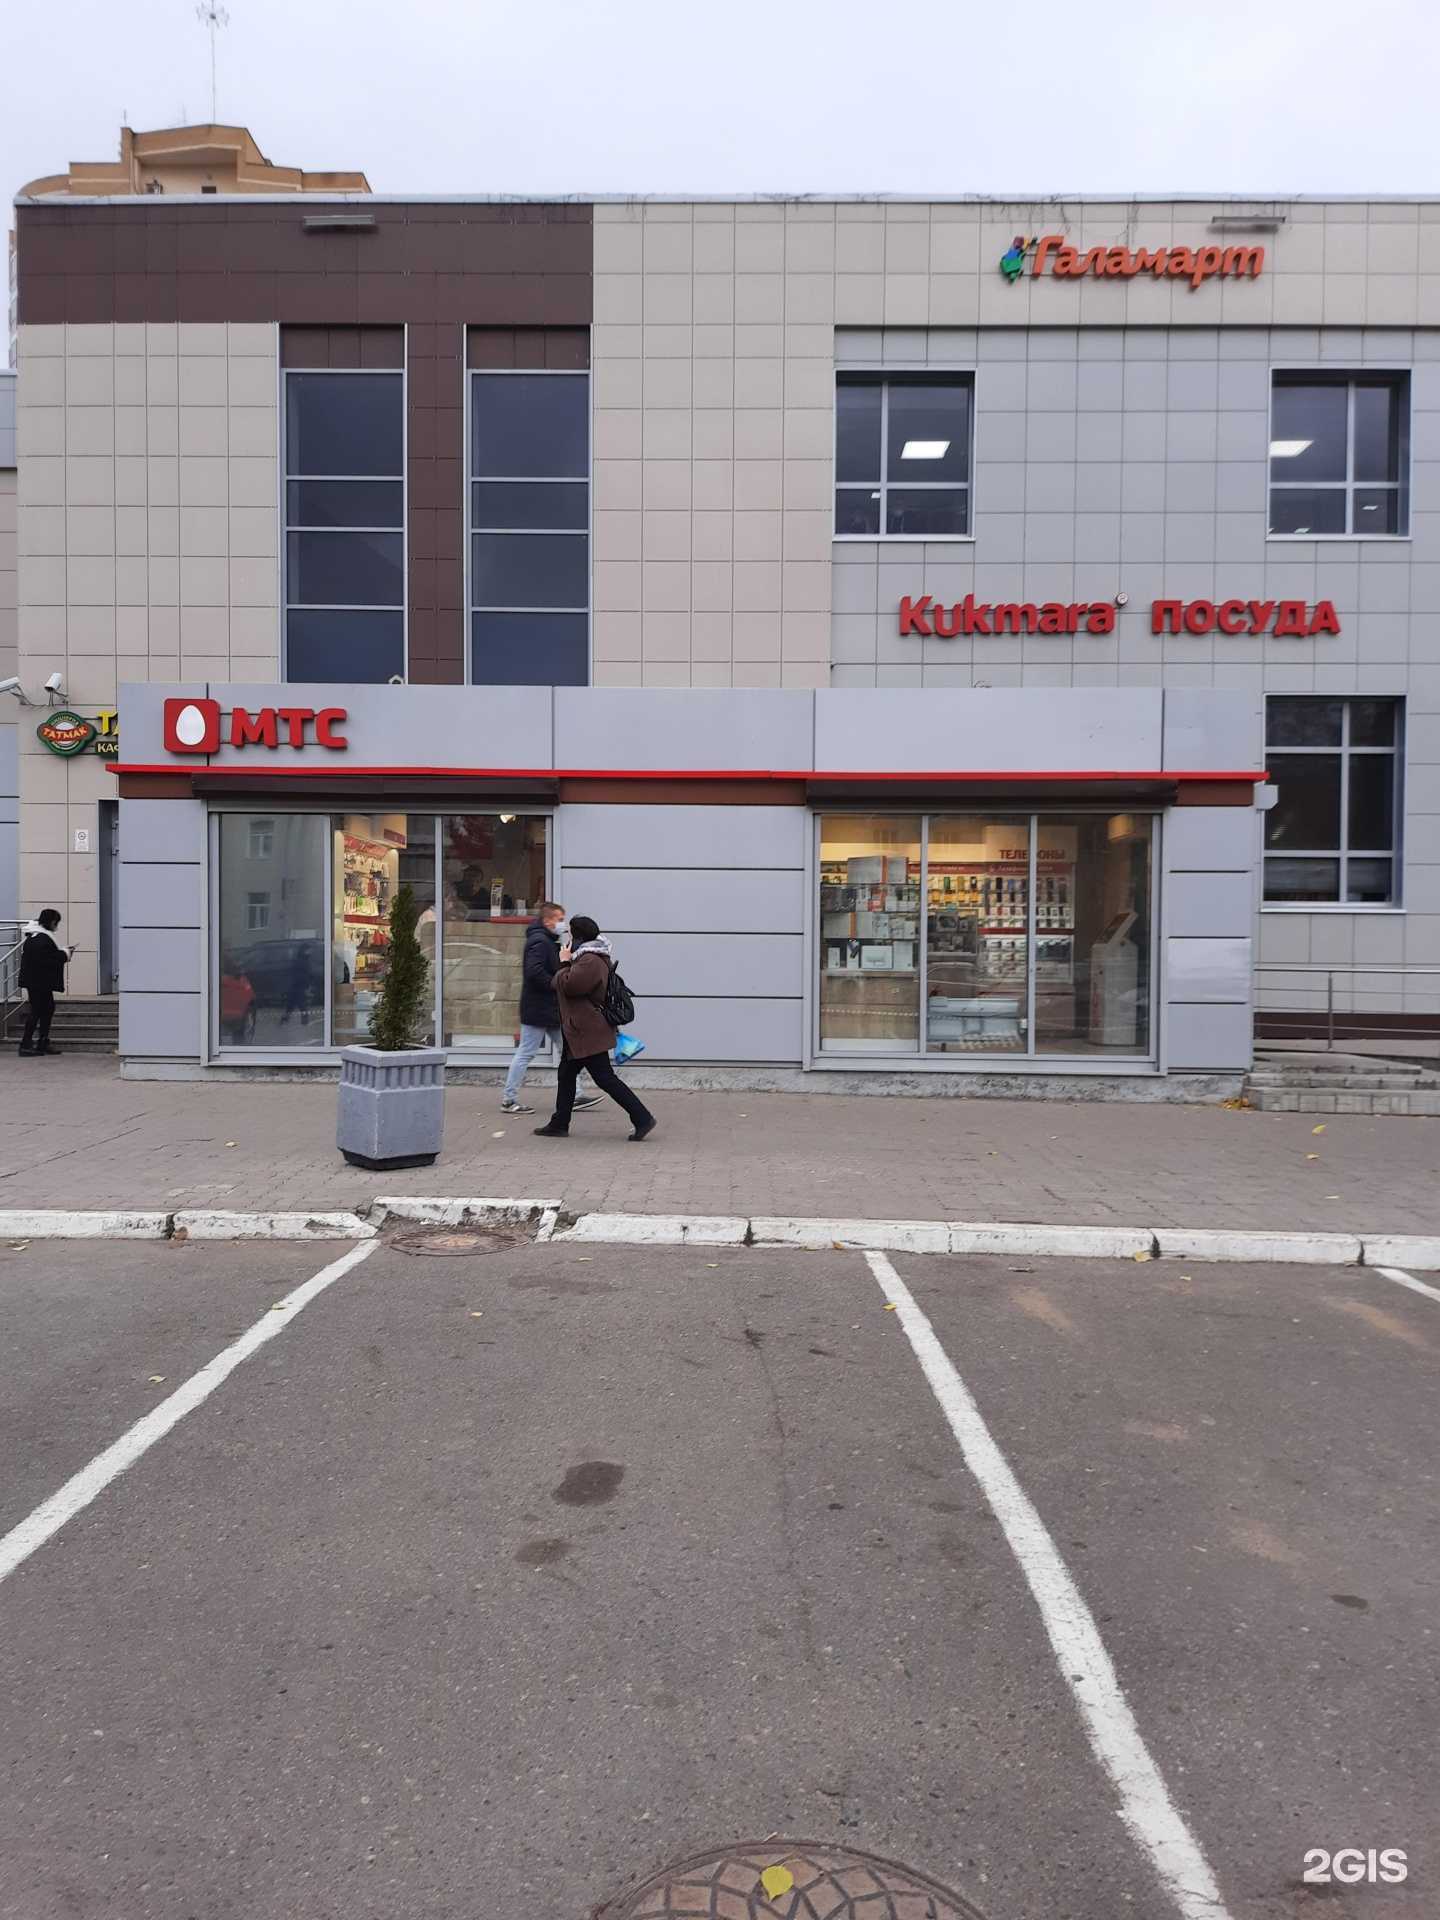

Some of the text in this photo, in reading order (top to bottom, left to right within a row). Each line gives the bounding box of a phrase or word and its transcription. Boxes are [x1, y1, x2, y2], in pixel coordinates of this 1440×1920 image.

[1031, 235, 1265, 289] Галамарт
[899, 594, 1115, 638] Kukmara
[1151, 600, 1341, 637] ПОСУДА
[231, 708, 348, 750] МТС
[1000, 849, 1065, 860] ТЕЛЕОНЫ
